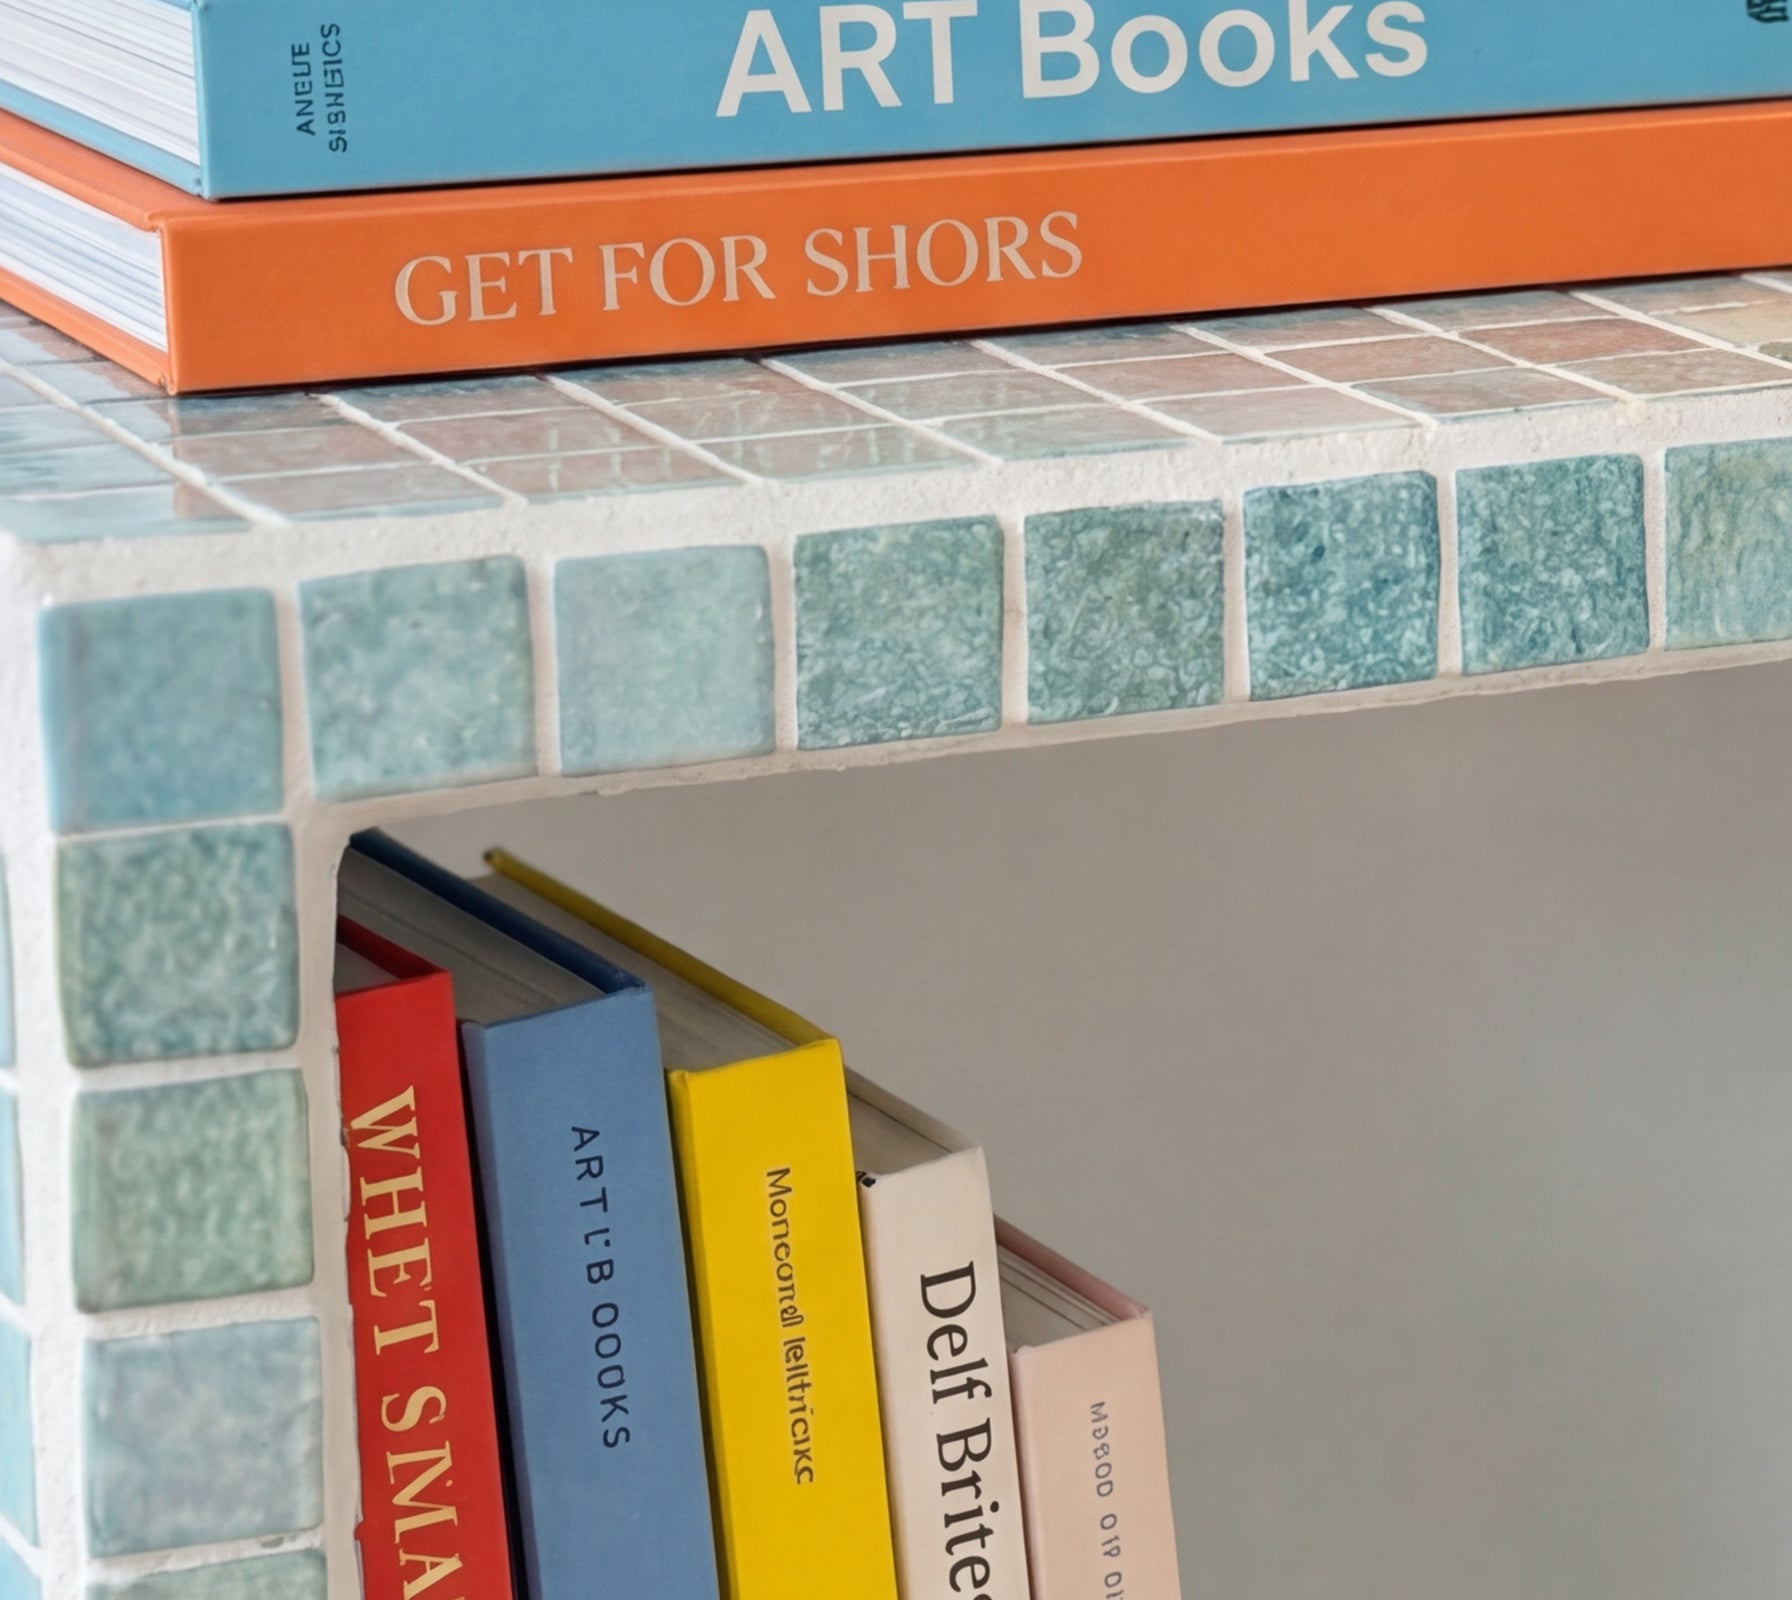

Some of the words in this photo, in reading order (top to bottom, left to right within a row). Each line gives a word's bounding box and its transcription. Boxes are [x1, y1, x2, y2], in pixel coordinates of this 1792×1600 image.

[394, 247, 575, 327] GET
[599, 233, 776, 312] FOR
[804, 210, 1084, 298] SHORS
[350, 1085, 442, 1356] WHET
[920, 1260, 993, 1405] Delf
